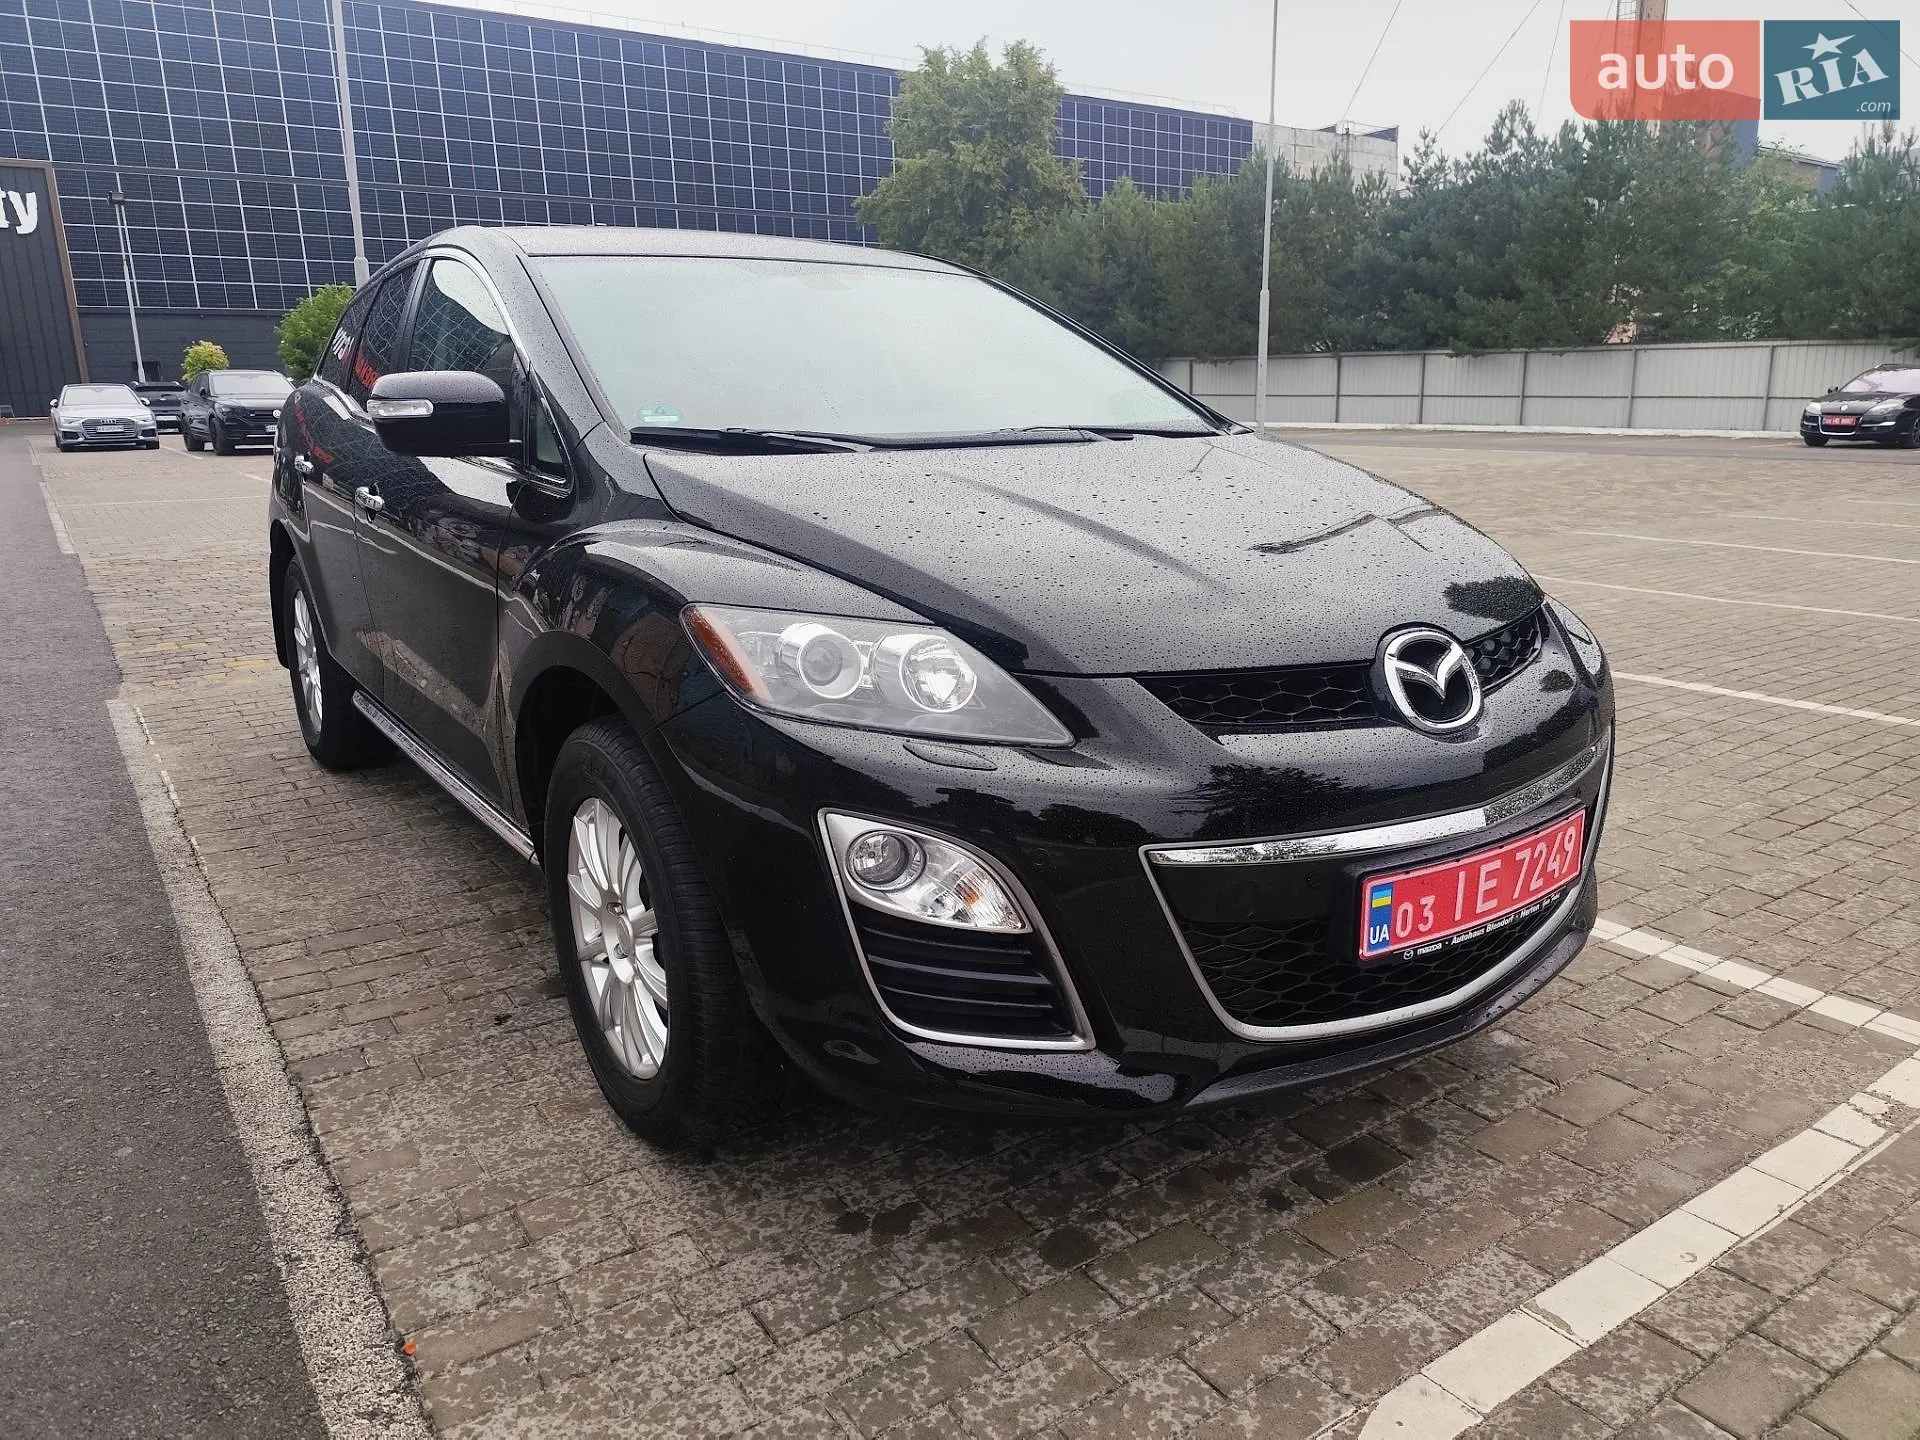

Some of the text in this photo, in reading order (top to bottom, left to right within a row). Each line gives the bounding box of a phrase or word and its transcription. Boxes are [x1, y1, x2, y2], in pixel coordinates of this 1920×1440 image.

[1395, 825, 1576, 938] 03 IE 7249
[1369, 924, 1390, 945] UA
[1451, 928, 1485, 946] Autohaus
